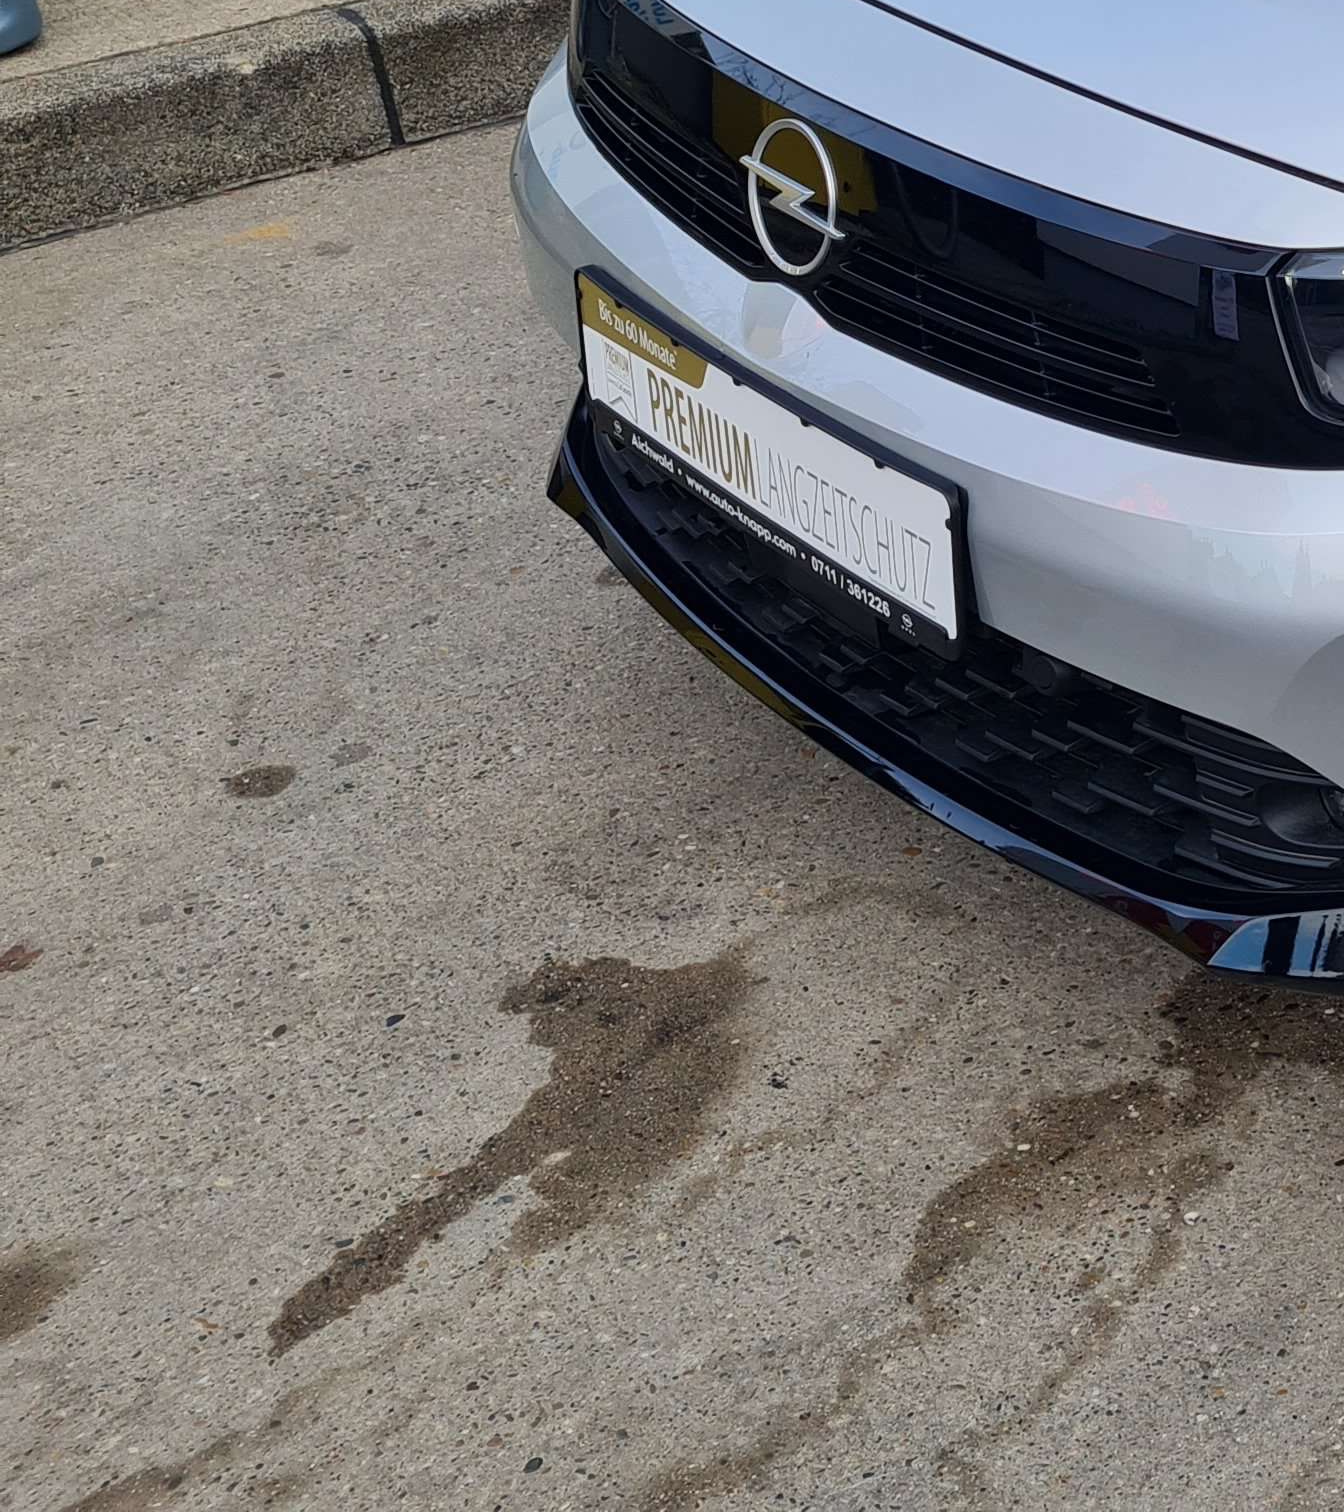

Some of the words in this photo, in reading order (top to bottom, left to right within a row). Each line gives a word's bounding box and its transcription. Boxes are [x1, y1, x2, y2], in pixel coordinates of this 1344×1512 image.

[597, 298, 612, 326] Bis
[612, 313, 625, 335] zu
[625, 319, 639, 345] 60
[631, 432, 674, 474] Aichwald
[685, 476, 798, 559] www.auto-knapp.com
[810, 556, 837, 585] 0711
